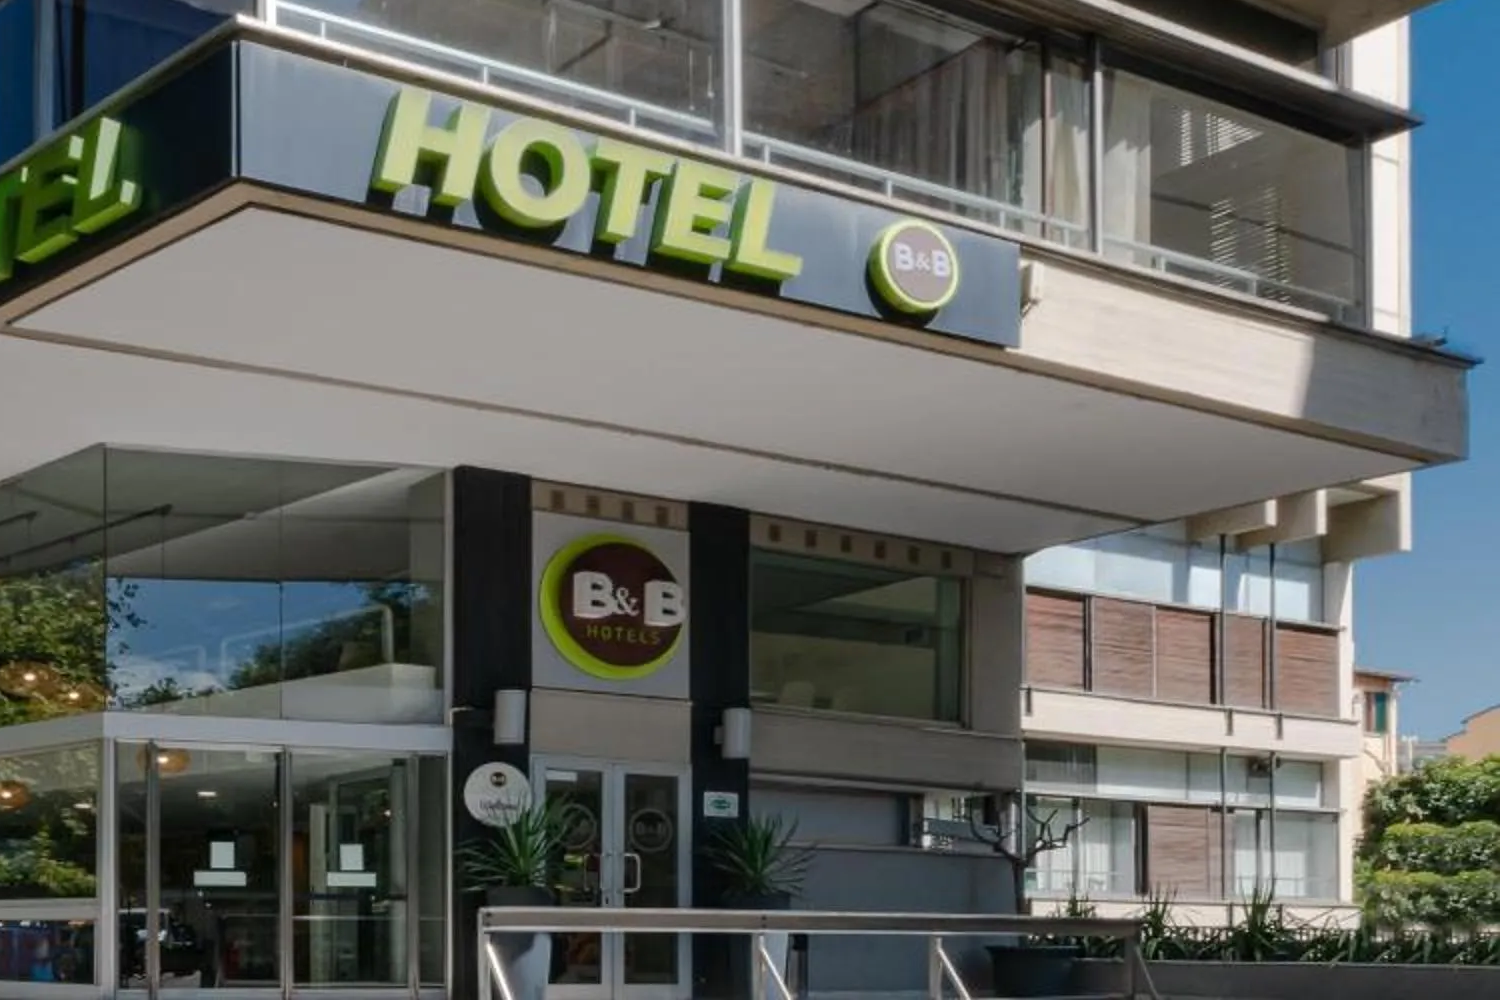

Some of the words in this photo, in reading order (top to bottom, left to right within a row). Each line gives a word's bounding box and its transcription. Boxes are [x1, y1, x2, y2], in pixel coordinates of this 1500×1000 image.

[371, 85, 802, 282] HOTEL
[895, 243, 951, 277] B&B
[573, 570, 686, 627] B&B
[586, 623, 661, 645] HOTELS
